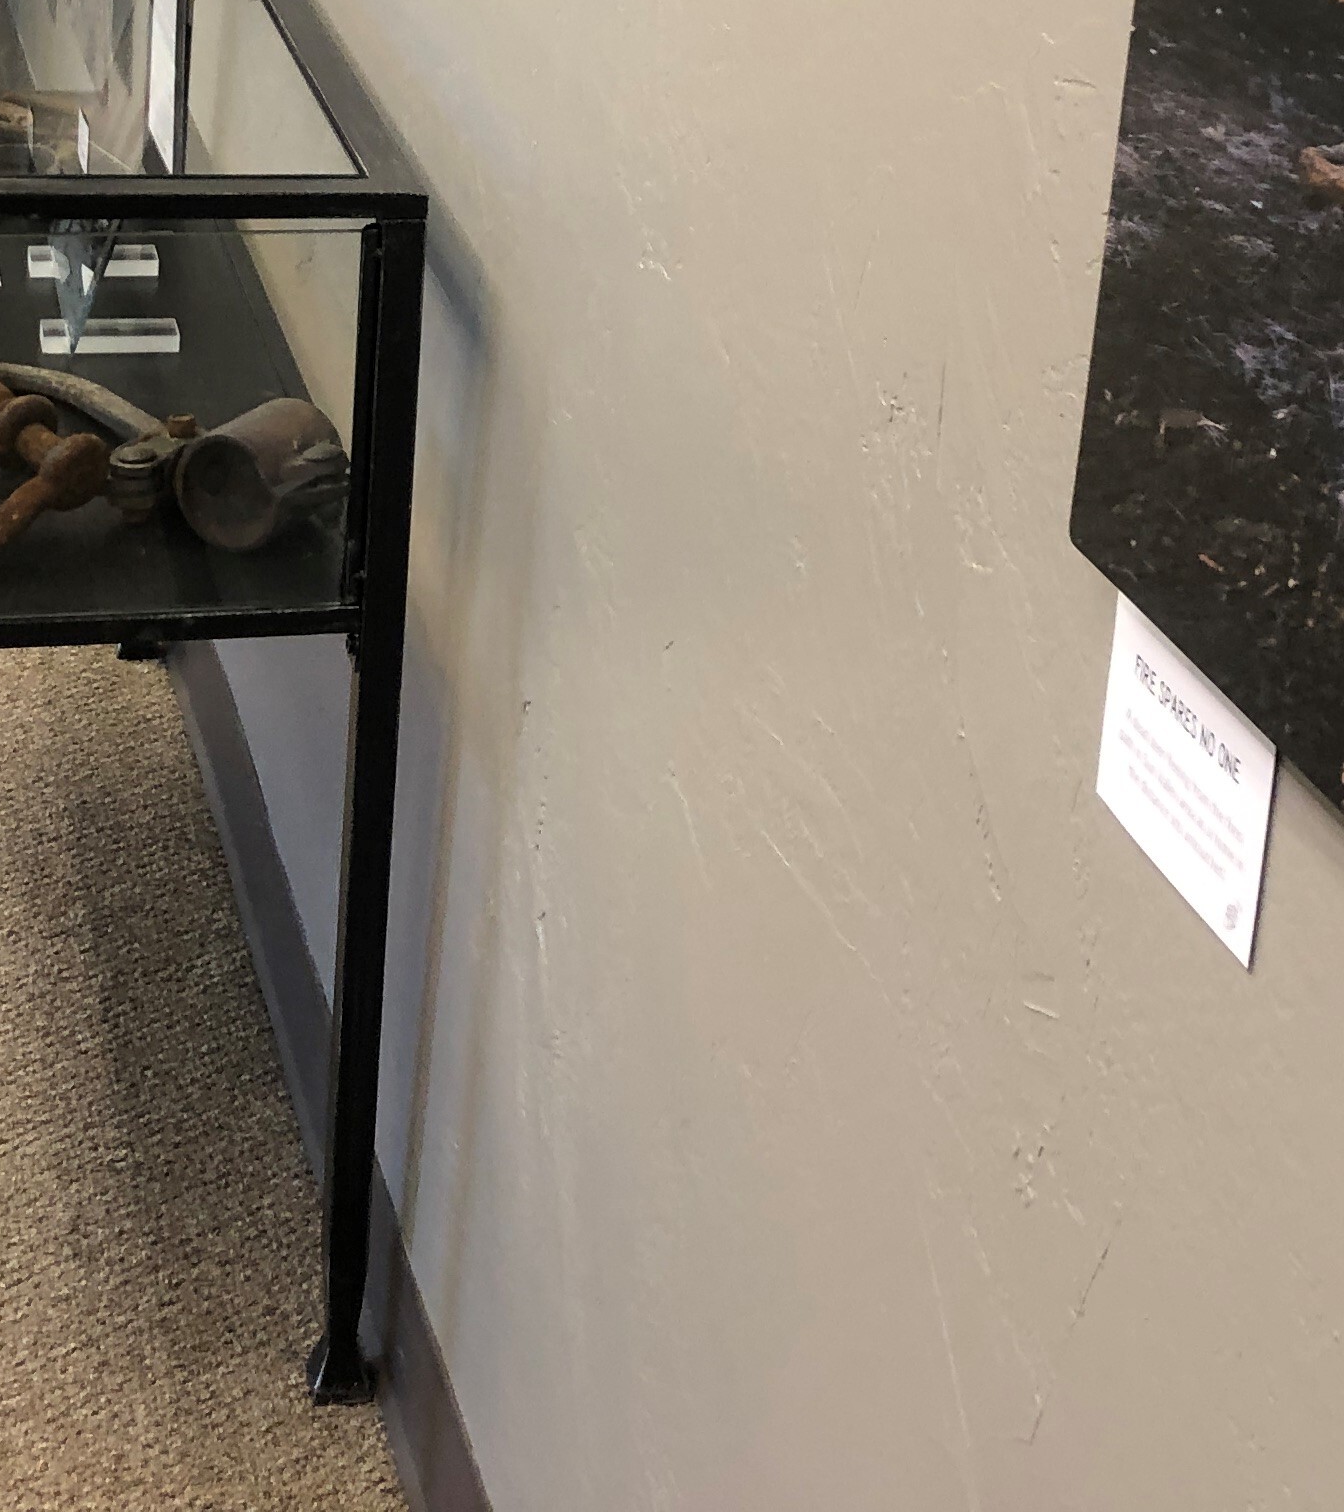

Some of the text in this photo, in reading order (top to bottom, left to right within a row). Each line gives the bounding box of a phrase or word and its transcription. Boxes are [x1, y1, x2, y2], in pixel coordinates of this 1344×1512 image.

[1135, 654, 1242, 785] FIRE SPARES NO ONE
